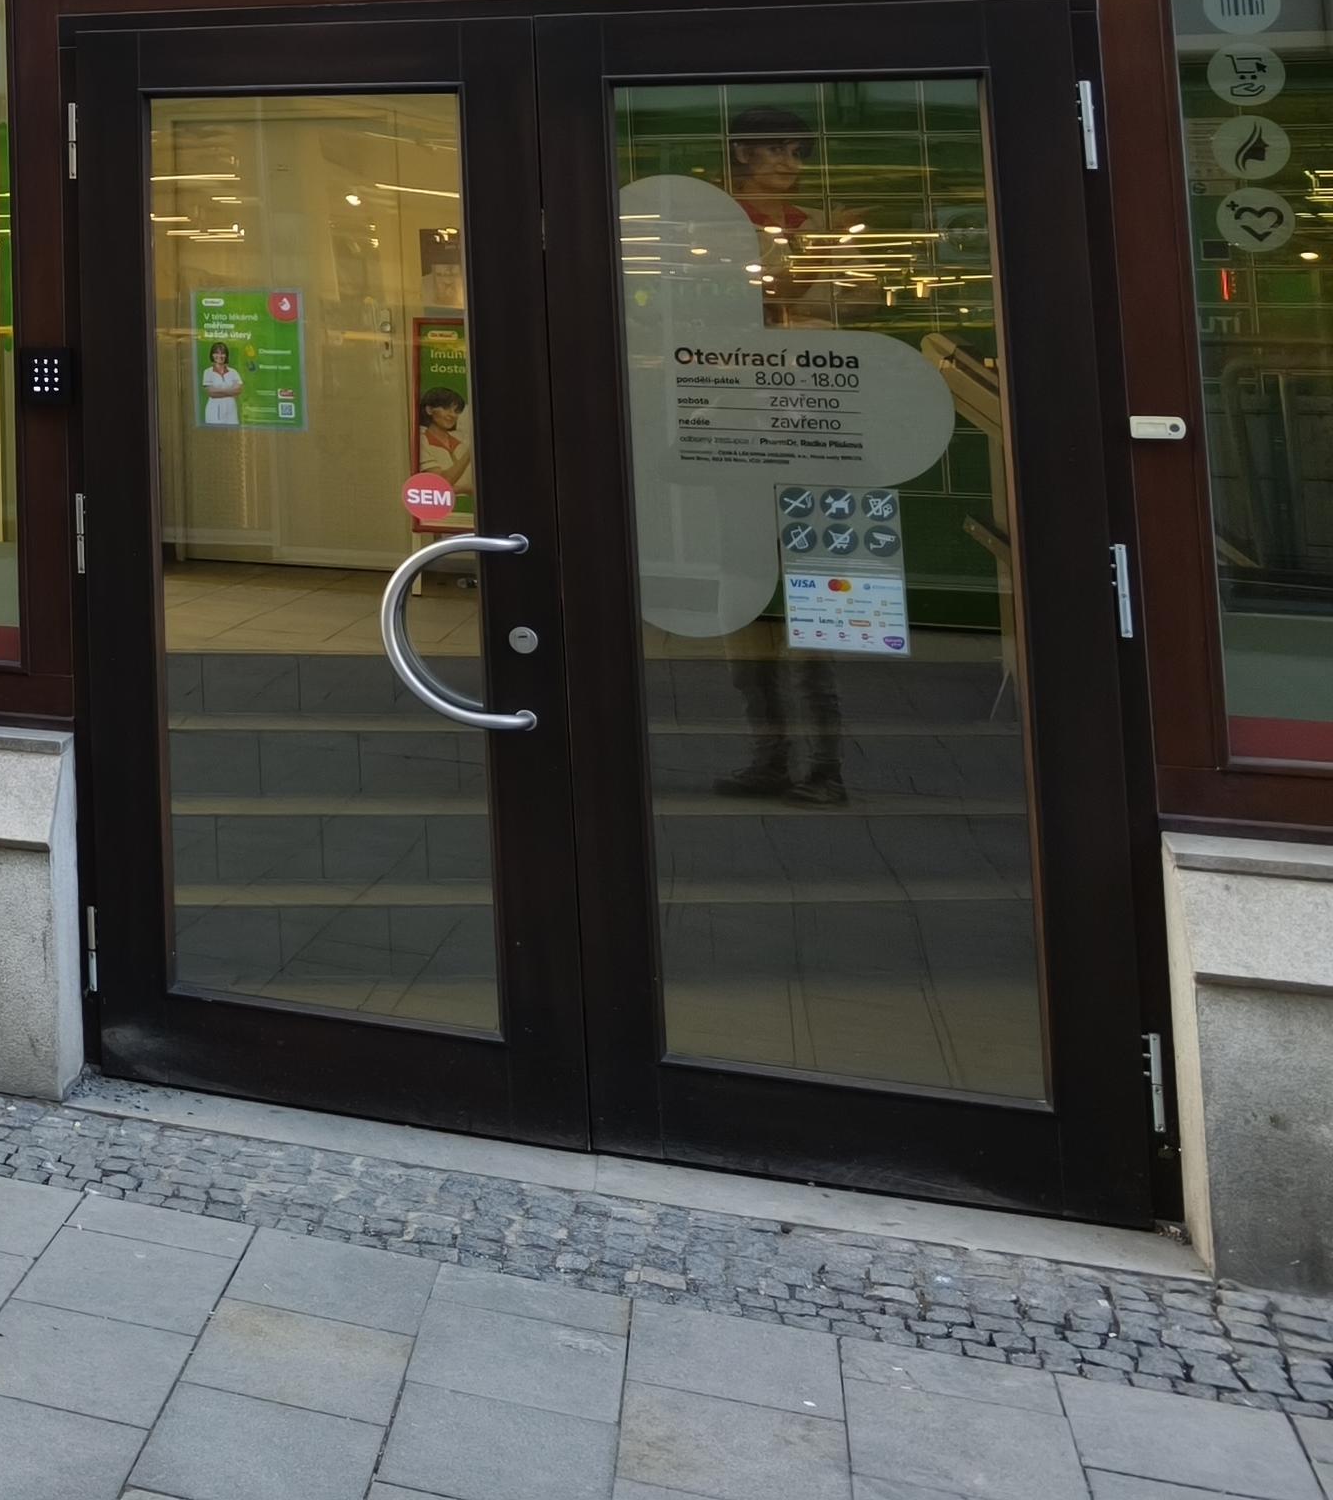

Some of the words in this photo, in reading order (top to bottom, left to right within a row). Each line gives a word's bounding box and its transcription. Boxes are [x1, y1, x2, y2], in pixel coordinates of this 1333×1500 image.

[430, 349, 466, 359] Imuni
[674, 347, 787, 368] Otevírací
[795, 350, 860, 369] doba
[430, 363, 466, 374] dosta
[755, 371, 796, 386] 8.00
[811, 373, 860, 388] 18.00
[677, 397, 710, 405] sobota
[769, 393, 841, 409] zavřeno
[678, 417, 711, 426] neděle
[770, 414, 842, 430] zavřeno
[407, 489, 452, 506] SEM
[790, 579, 816, 589] VISA
